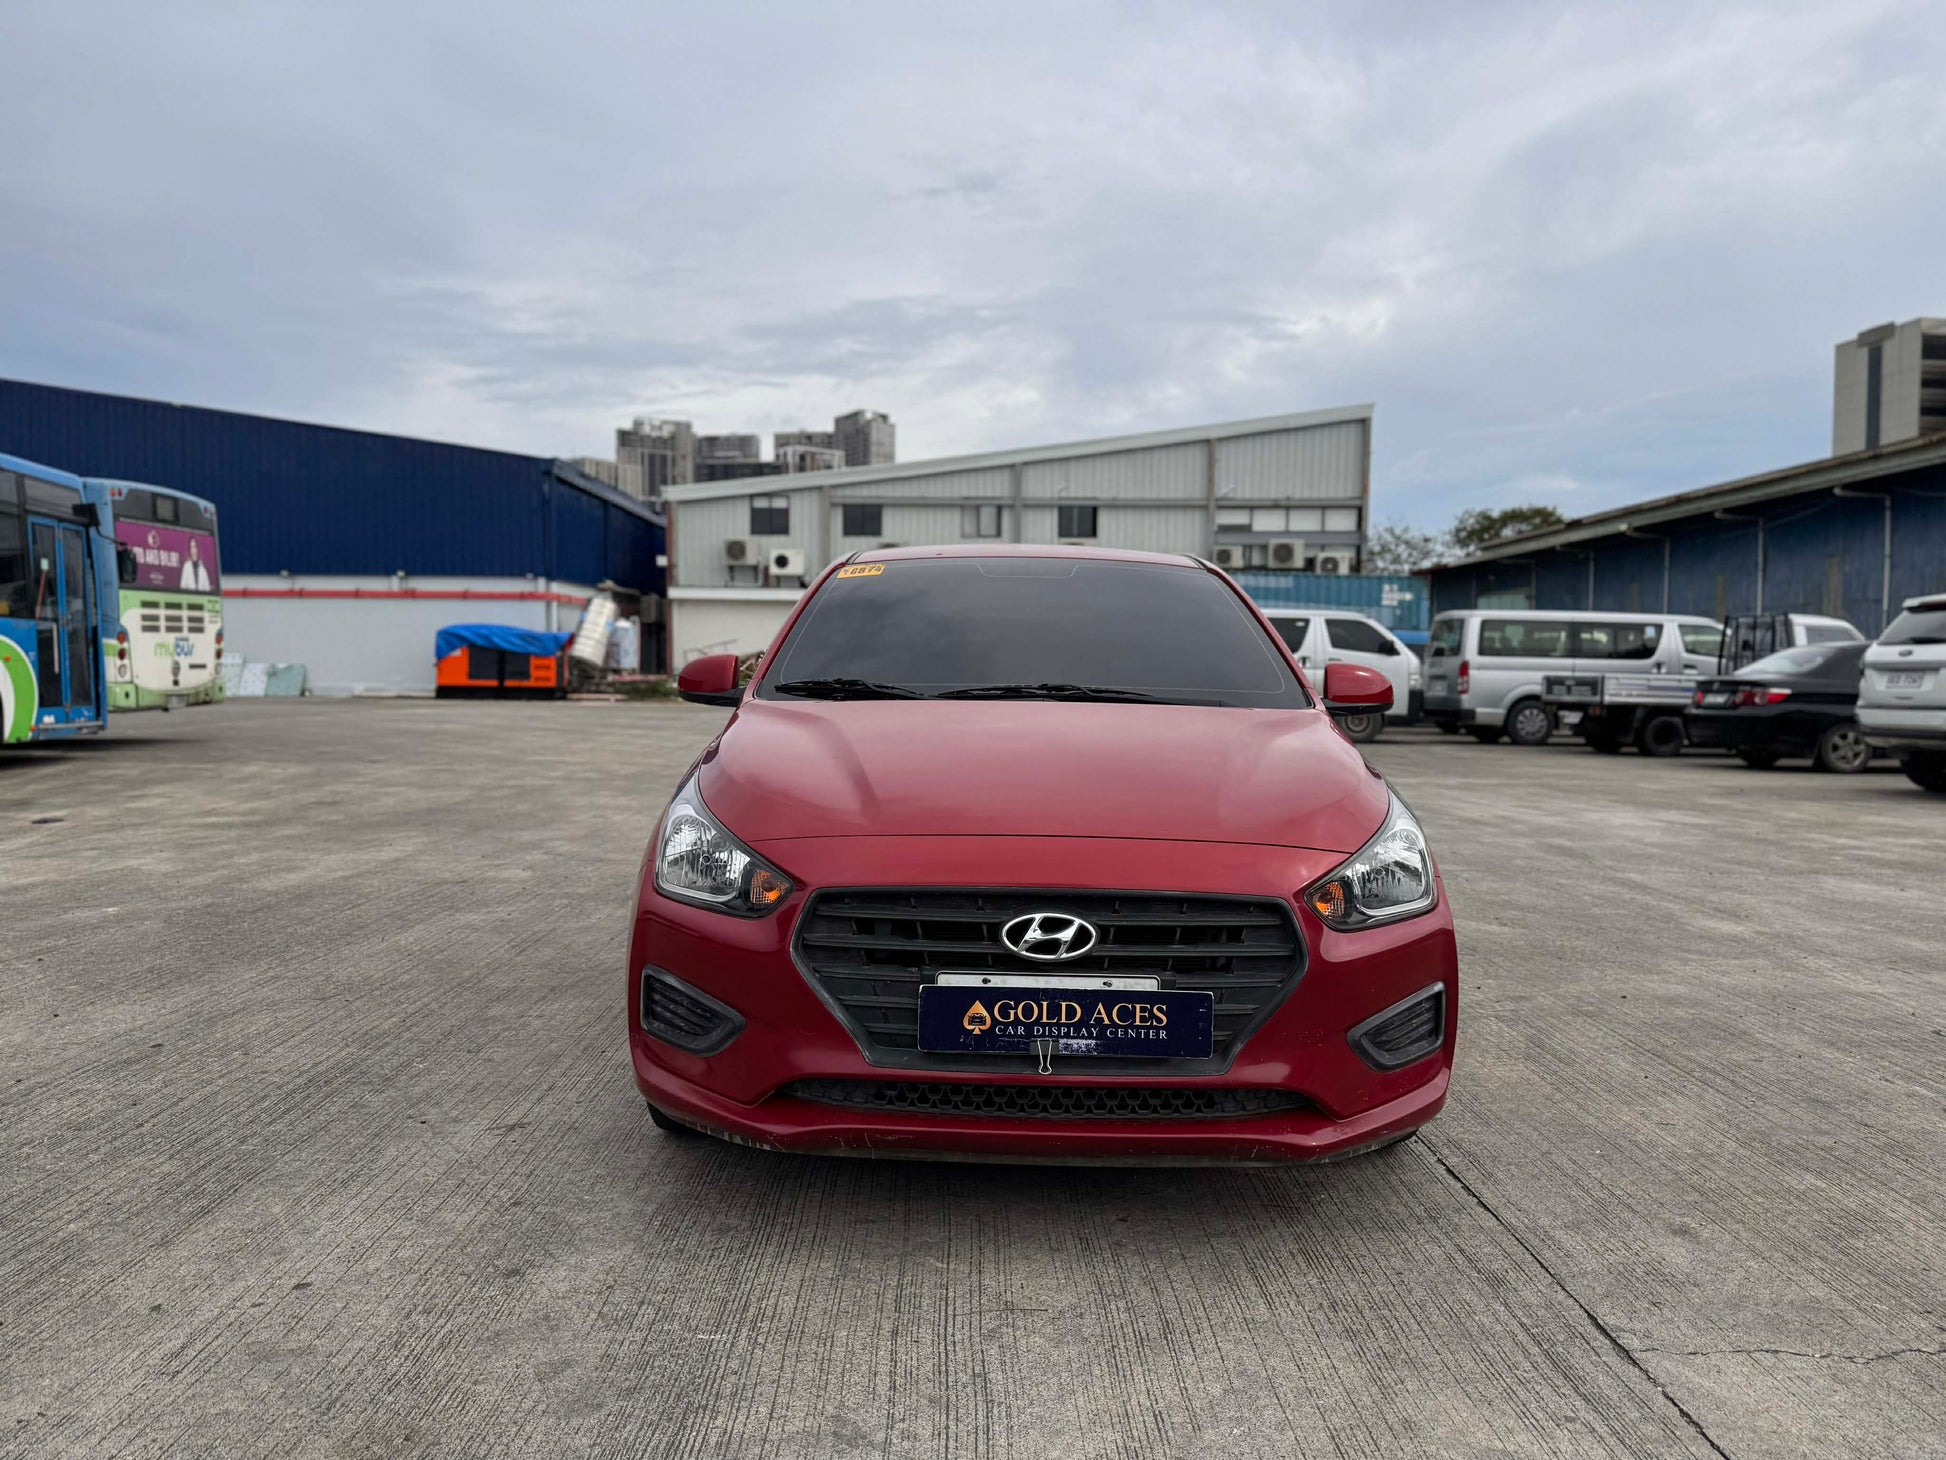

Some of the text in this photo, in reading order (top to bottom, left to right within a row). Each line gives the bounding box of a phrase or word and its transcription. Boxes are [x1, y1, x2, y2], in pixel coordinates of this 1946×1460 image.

[993, 1000, 1168, 1027] GOLD ACES
[995, 1025, 1168, 1039] CAR DISPLAY CENTER
